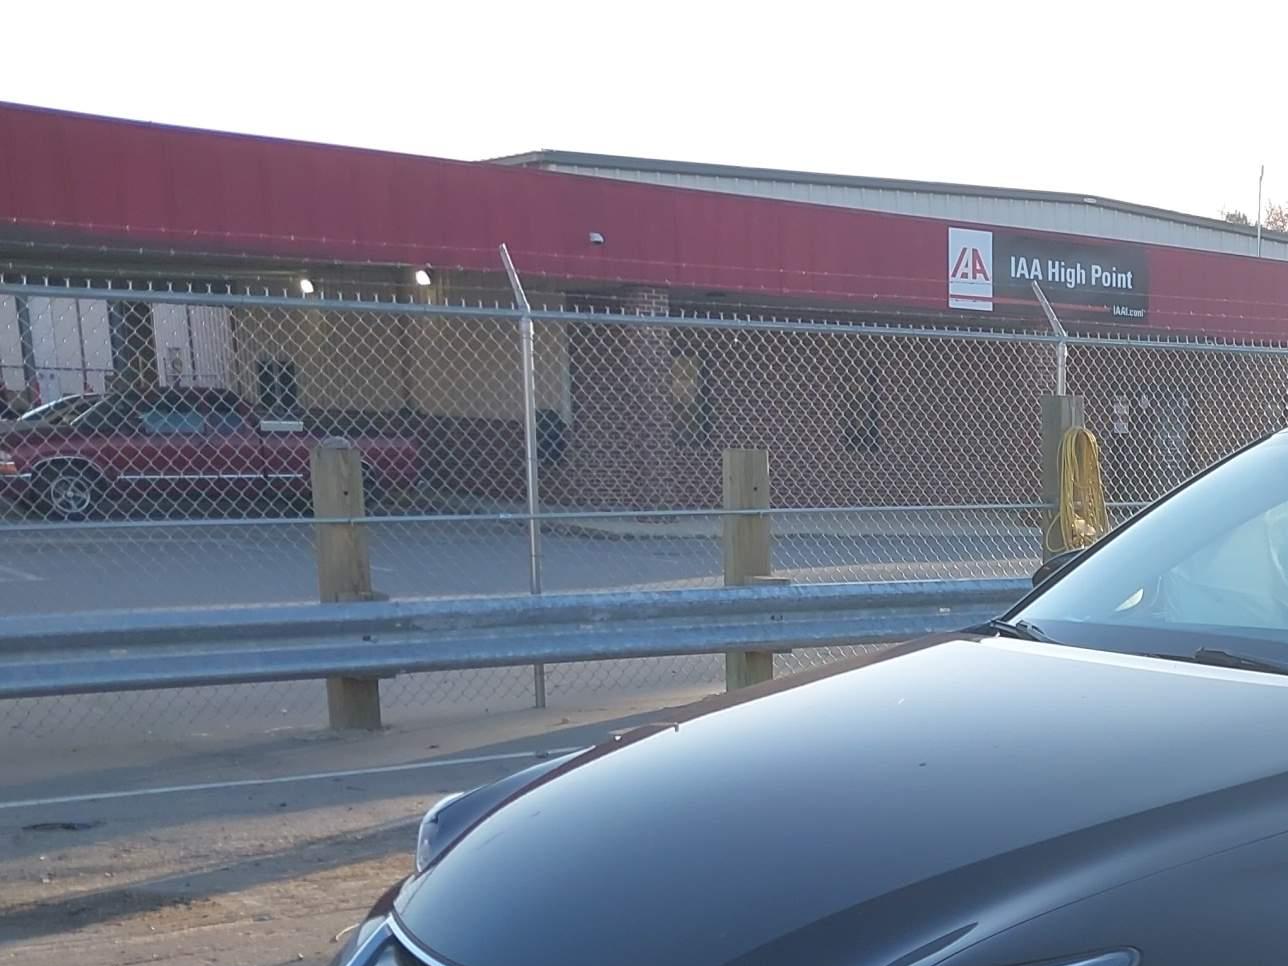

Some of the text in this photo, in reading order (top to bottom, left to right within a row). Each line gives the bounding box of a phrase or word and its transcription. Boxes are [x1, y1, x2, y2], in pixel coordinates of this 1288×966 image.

[1010, 255, 1133, 289] IAA High Point
